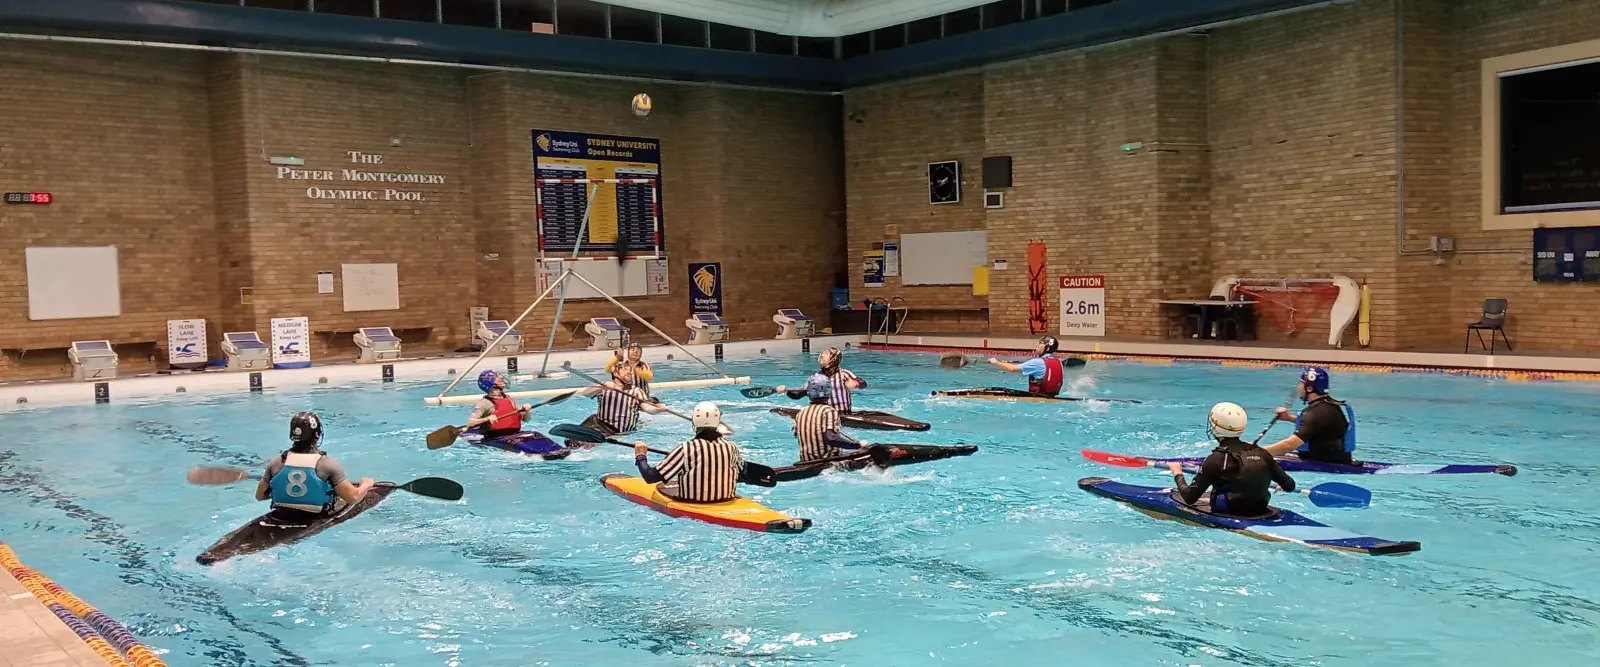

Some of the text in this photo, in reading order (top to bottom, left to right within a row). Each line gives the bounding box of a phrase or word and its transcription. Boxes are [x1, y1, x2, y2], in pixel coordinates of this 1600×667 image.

[552, 139, 570, 148] Sydney
[587, 138, 657, 150] SYDNEY UNIVERSITY
[347, 151, 384, 164] THE
[587, 148, 634, 158] Open Records
[276, 166, 446, 184] PETER MONTGOMERY
[306, 186, 426, 201] OLYMPIC POOL
[1063, 277, 1101, 287] CAUTION
[1065, 300, 1100, 315] 2.6m
[1066, 321, 1098, 329] Deep Water
[244, 359, 253, 369] 3
[510, 359, 516, 368] 5
[386, 368, 391, 376] 4
[1307, 367, 1317, 382] 6
[252, 376, 259, 386] 3
[98, 387, 105, 397] 2
[309, 416, 318, 429] 8
[285, 469, 308, 498] 8
